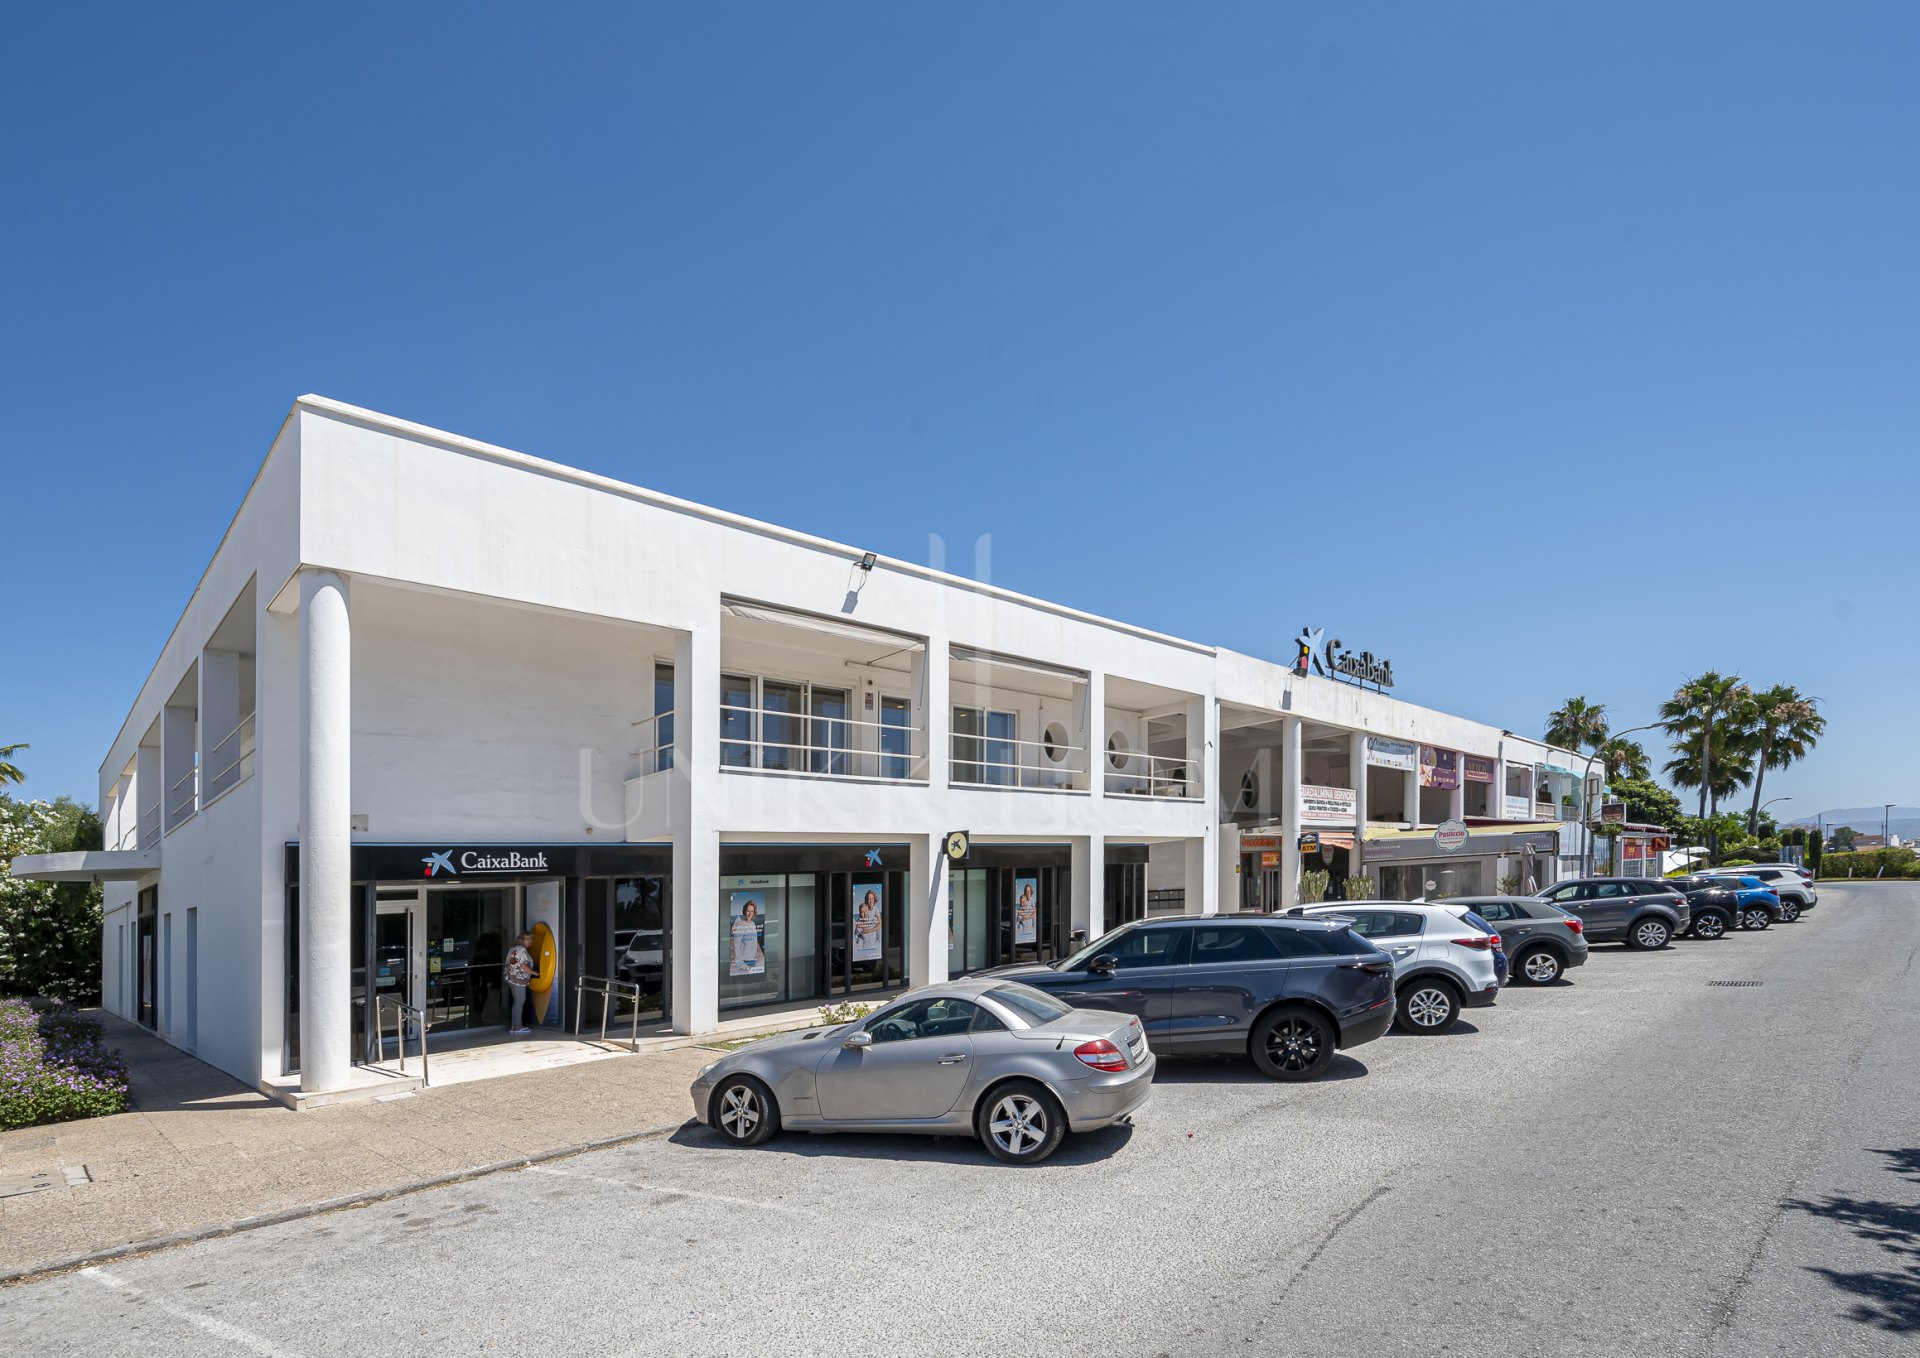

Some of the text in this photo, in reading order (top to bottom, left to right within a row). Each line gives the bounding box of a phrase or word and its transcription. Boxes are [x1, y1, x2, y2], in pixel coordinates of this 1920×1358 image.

[1326, 639, 1394, 687] CaixaBank
[1655, 838, 1667, 849] N
[460, 851, 548, 869] CaixaBank
